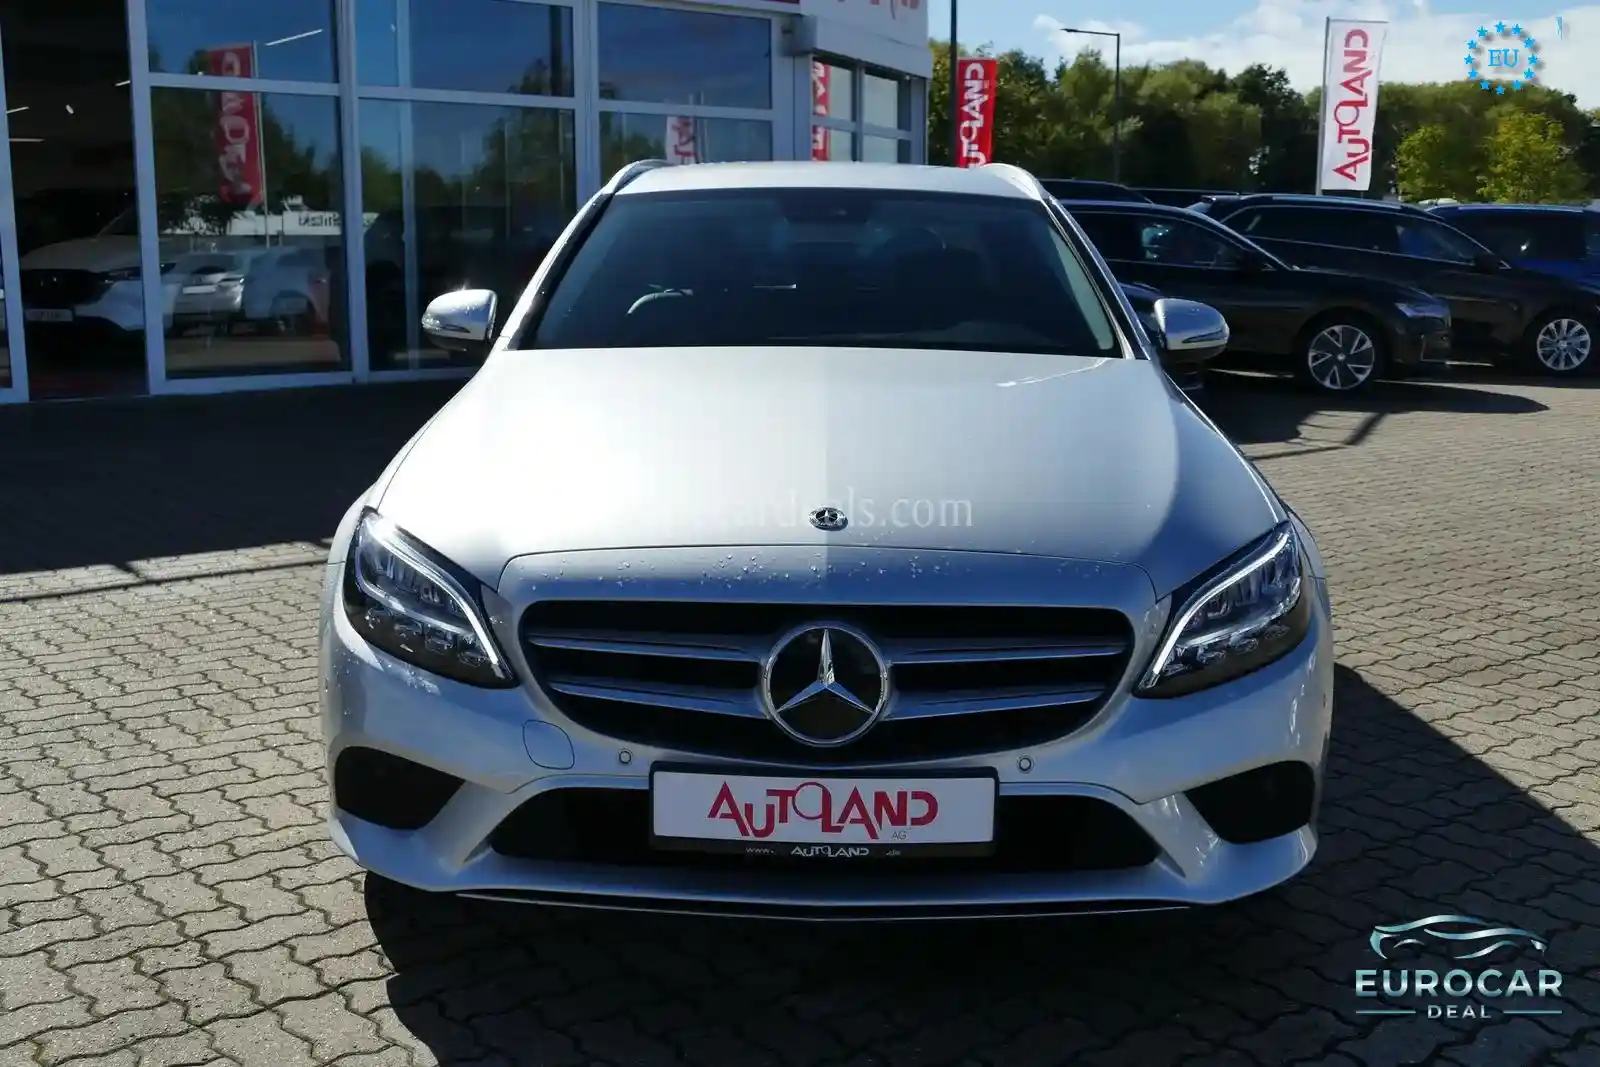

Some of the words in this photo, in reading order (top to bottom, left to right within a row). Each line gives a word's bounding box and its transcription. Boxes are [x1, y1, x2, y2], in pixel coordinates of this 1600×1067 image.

[1333, 29, 1372, 182] AUTOLAND
[707, 781, 939, 840] AUTOLAND
[791, 845, 870, 857] AUTOLAND
[891, 830, 908, 841] AG
